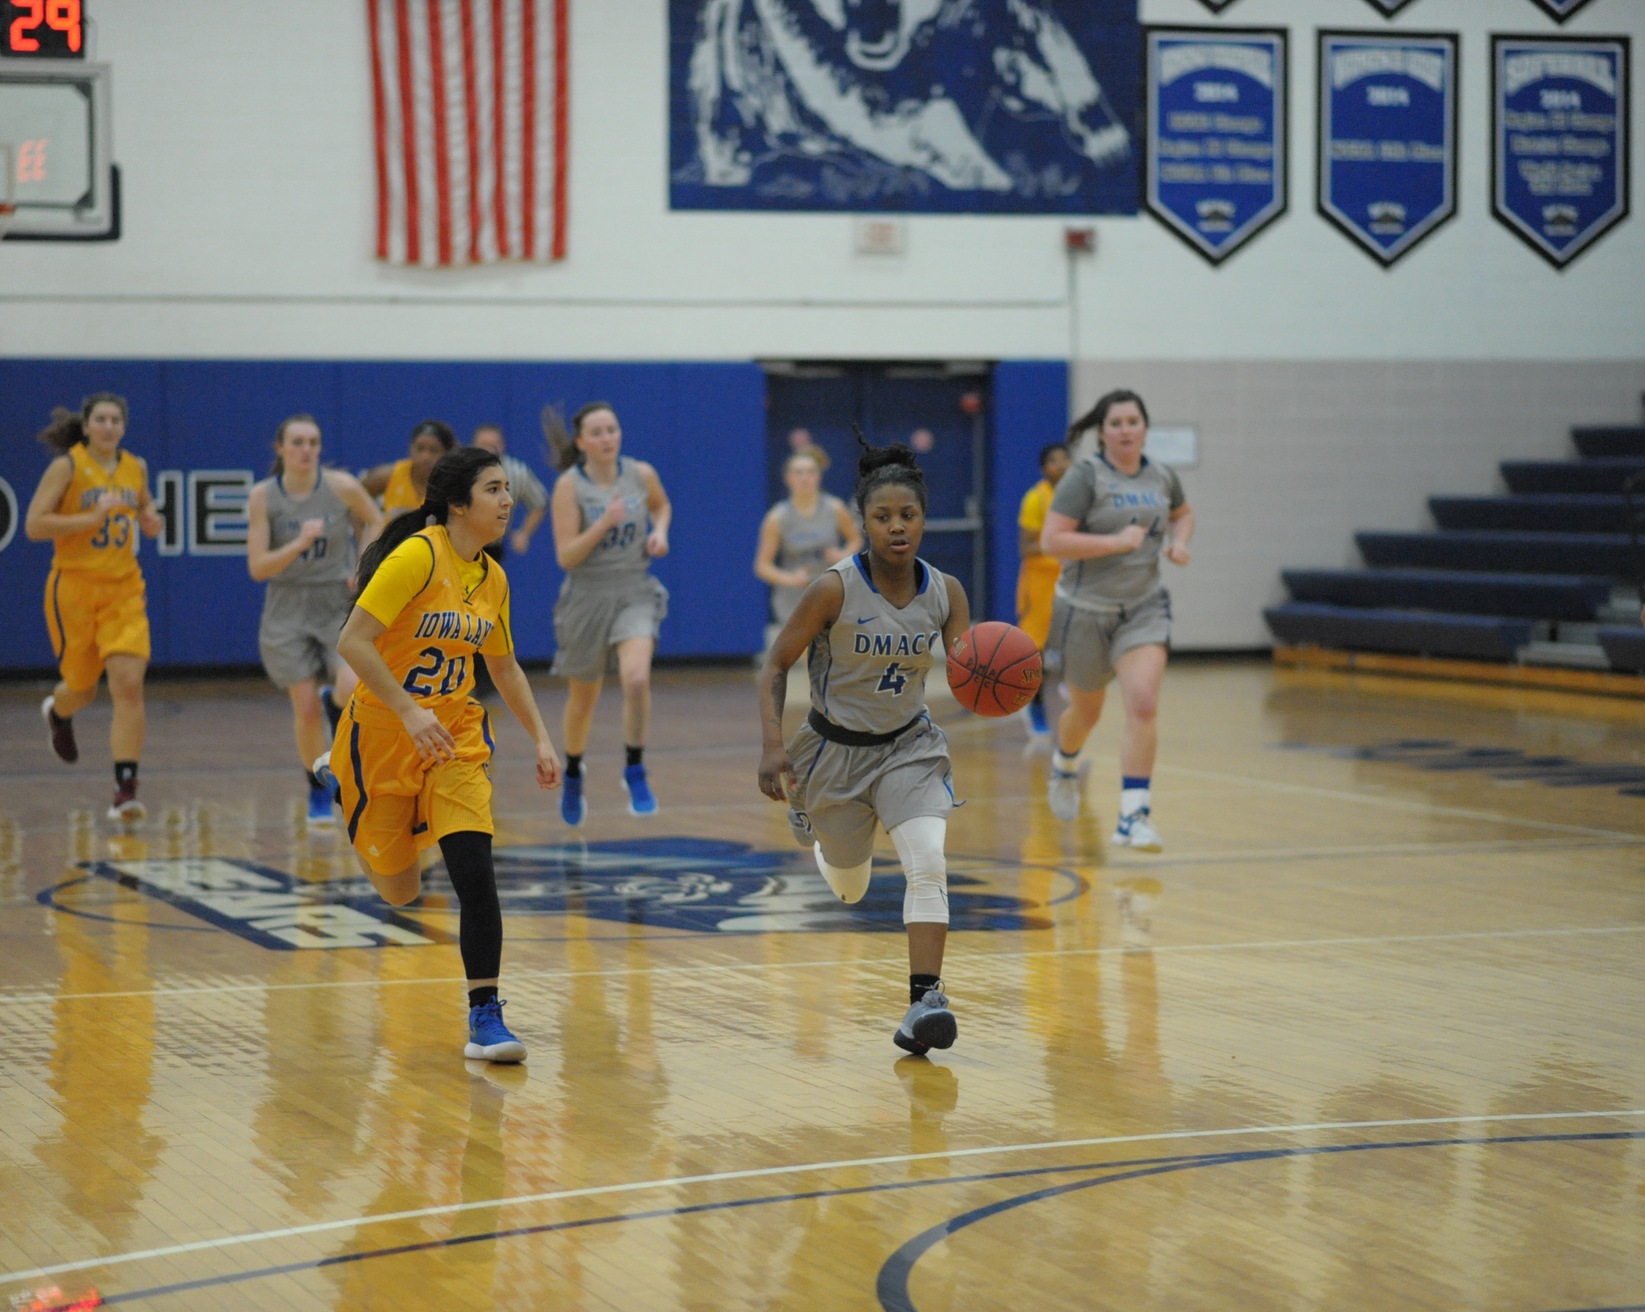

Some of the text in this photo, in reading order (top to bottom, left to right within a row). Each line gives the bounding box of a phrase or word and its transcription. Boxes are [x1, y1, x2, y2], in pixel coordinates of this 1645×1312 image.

[9, 0, 82, 52] 29
[91, 512, 130, 550] 33
[413, 611, 463, 640] IOWA
[402, 645, 467, 697] 20
[874, 661, 908, 697] 4
